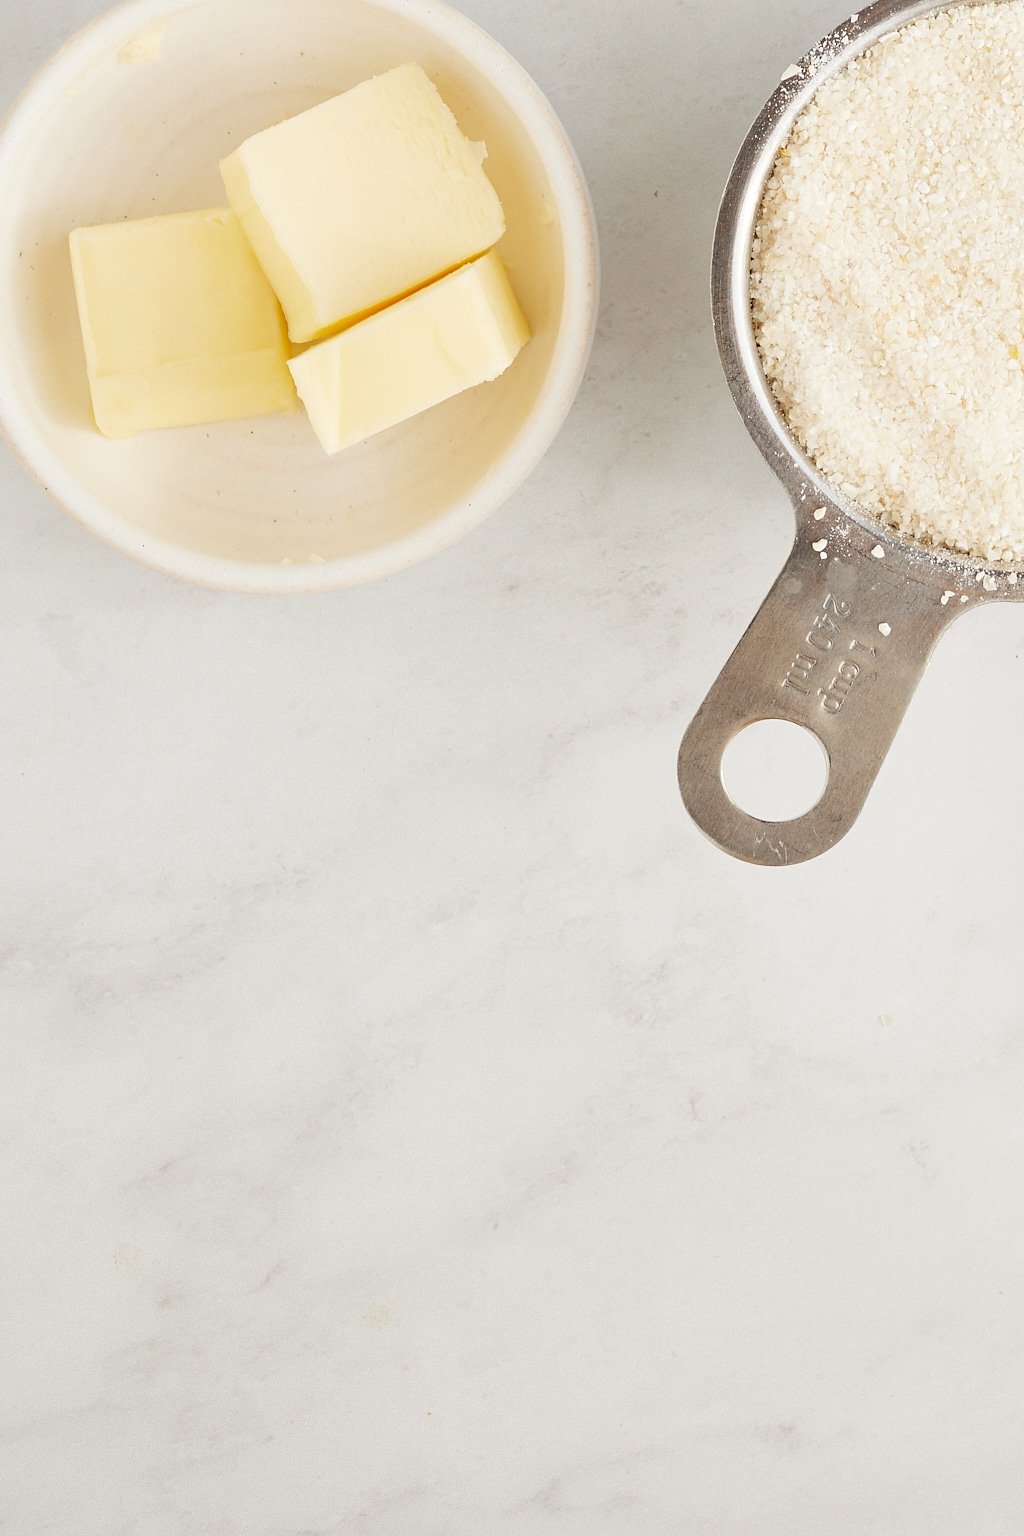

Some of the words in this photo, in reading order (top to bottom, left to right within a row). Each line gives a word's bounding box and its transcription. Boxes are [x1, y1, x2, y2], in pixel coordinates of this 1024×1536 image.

[807, 593, 852, 651] 240
[781, 654, 816, 695] ml
[818, 660, 861, 714] cup
